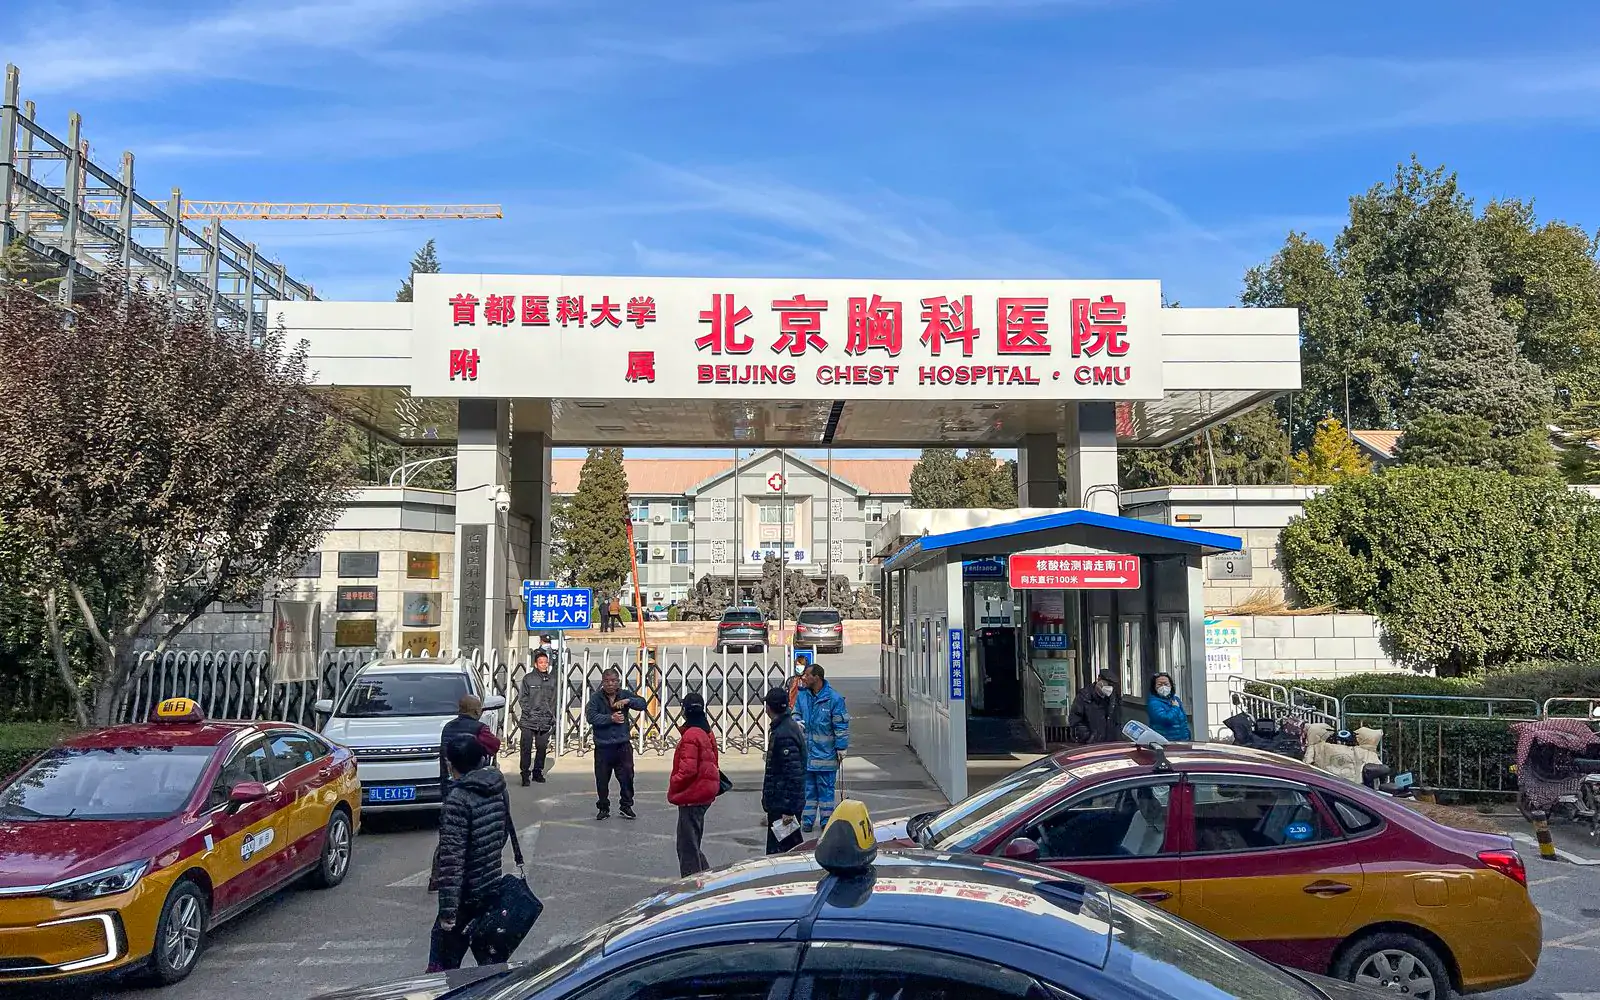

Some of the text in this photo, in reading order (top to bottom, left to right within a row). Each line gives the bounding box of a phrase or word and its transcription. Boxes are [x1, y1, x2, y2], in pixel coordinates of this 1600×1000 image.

[449, 293, 656, 329] 首都医科大学
[695, 293, 1130, 357] 北京胸科医院
[449, 349, 655, 383] 附 属
[697, 364, 796, 384] BEIJING
[816, 365, 899, 385] CHEST
[919, 365, 1040, 385] HOSPITAL
[1074, 365, 1130, 385] CMU
[1036, 559, 1136, 571] 核酸检测请走南1门
[1226, 561, 1234, 573] 9
[1021, 575, 1079, 584] 向东直行100米
[532, 594, 587, 607] 非机动车
[532, 610, 587, 624] 禁止入内
[163, 701, 186, 712] 新月
